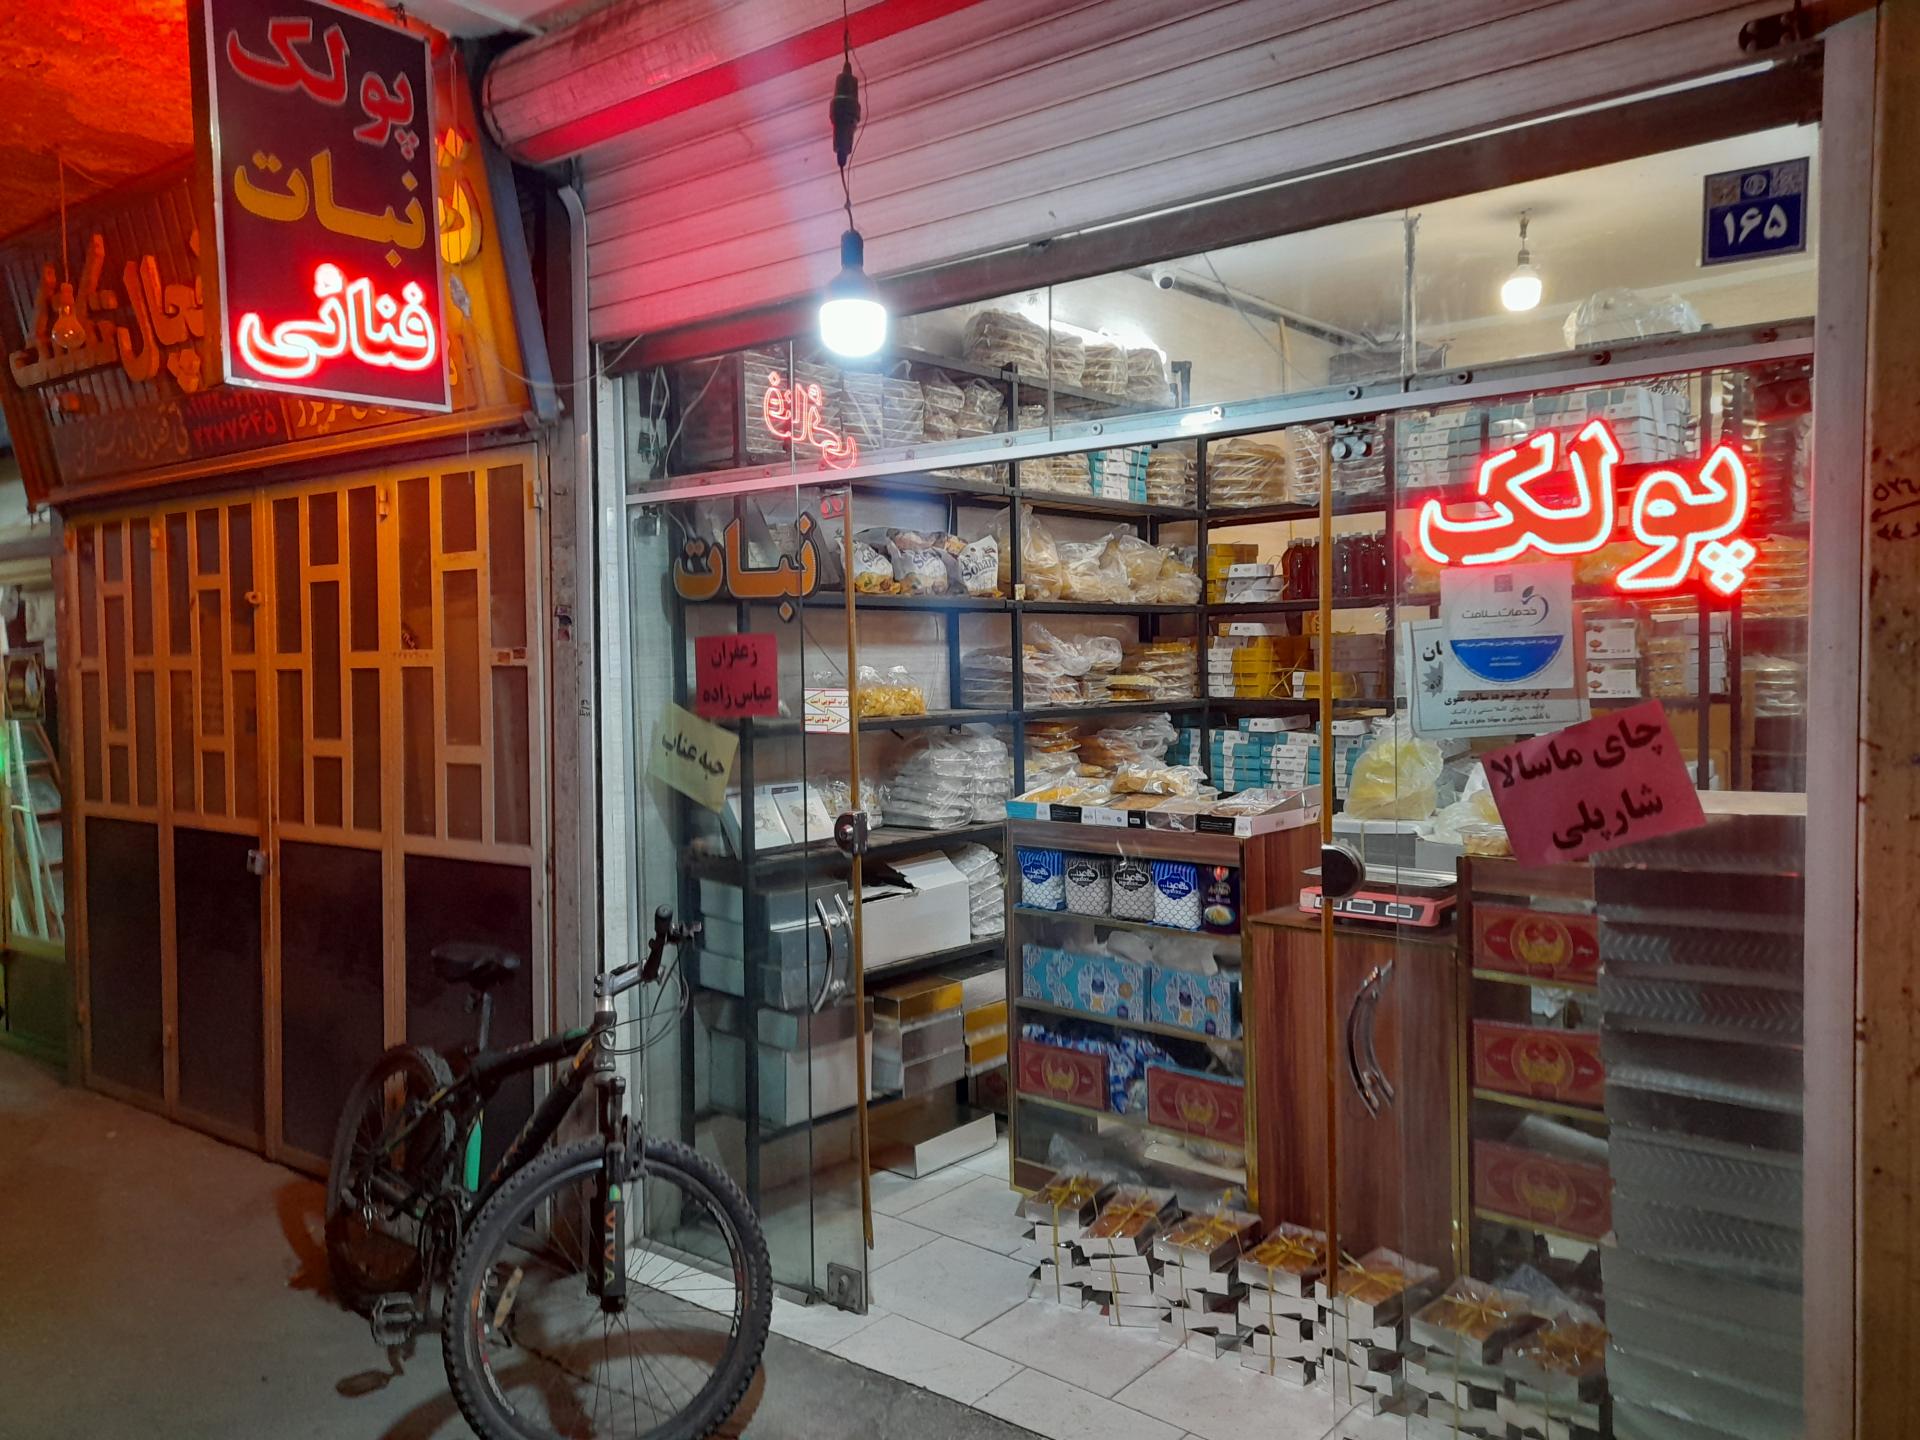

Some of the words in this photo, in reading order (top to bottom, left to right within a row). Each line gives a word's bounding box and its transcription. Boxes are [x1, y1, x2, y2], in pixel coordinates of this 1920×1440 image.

[234, 149, 426, 268] نبات
[1723, 203, 1788, 247] ۱۶۵
[1419, 420, 1756, 595] پولک
[673, 511, 818, 623] نبات
[1461, 608, 1499, 619] سلامت
[1499, 607, 1538, 617] خدمات
[711, 639, 758, 667] زعفران
[703, 684, 732, 708] زاده
[735, 683, 772, 708] عباس
[1490, 739, 1583, 788] ماسالا
[1593, 719, 1661, 768] چای
